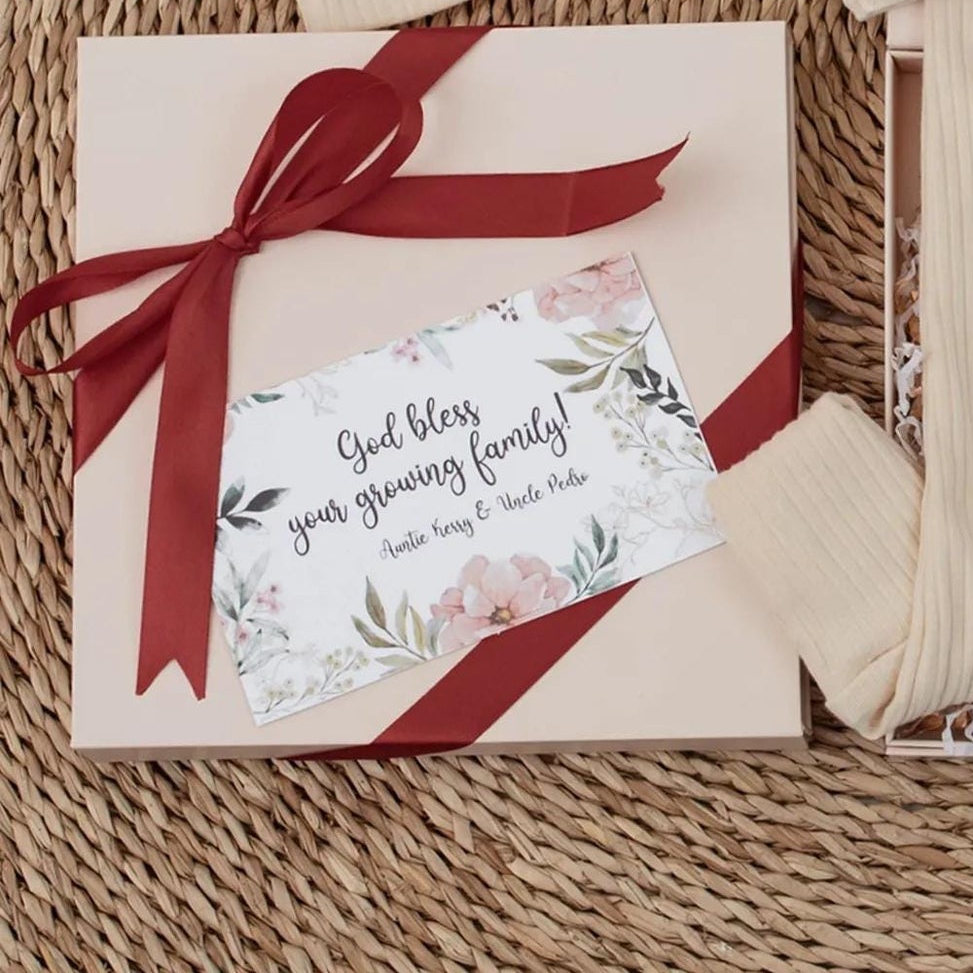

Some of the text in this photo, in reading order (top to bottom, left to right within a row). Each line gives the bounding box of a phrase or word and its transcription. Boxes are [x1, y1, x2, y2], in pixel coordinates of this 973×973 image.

[288, 391, 572, 557] your growing family!
[337, 397, 481, 475] God bless
[380, 529, 429, 560] Auntie
[475, 499, 491, 521] &
[496, 483, 545, 512] Uncle
[548, 467, 590, 494] Pedro
